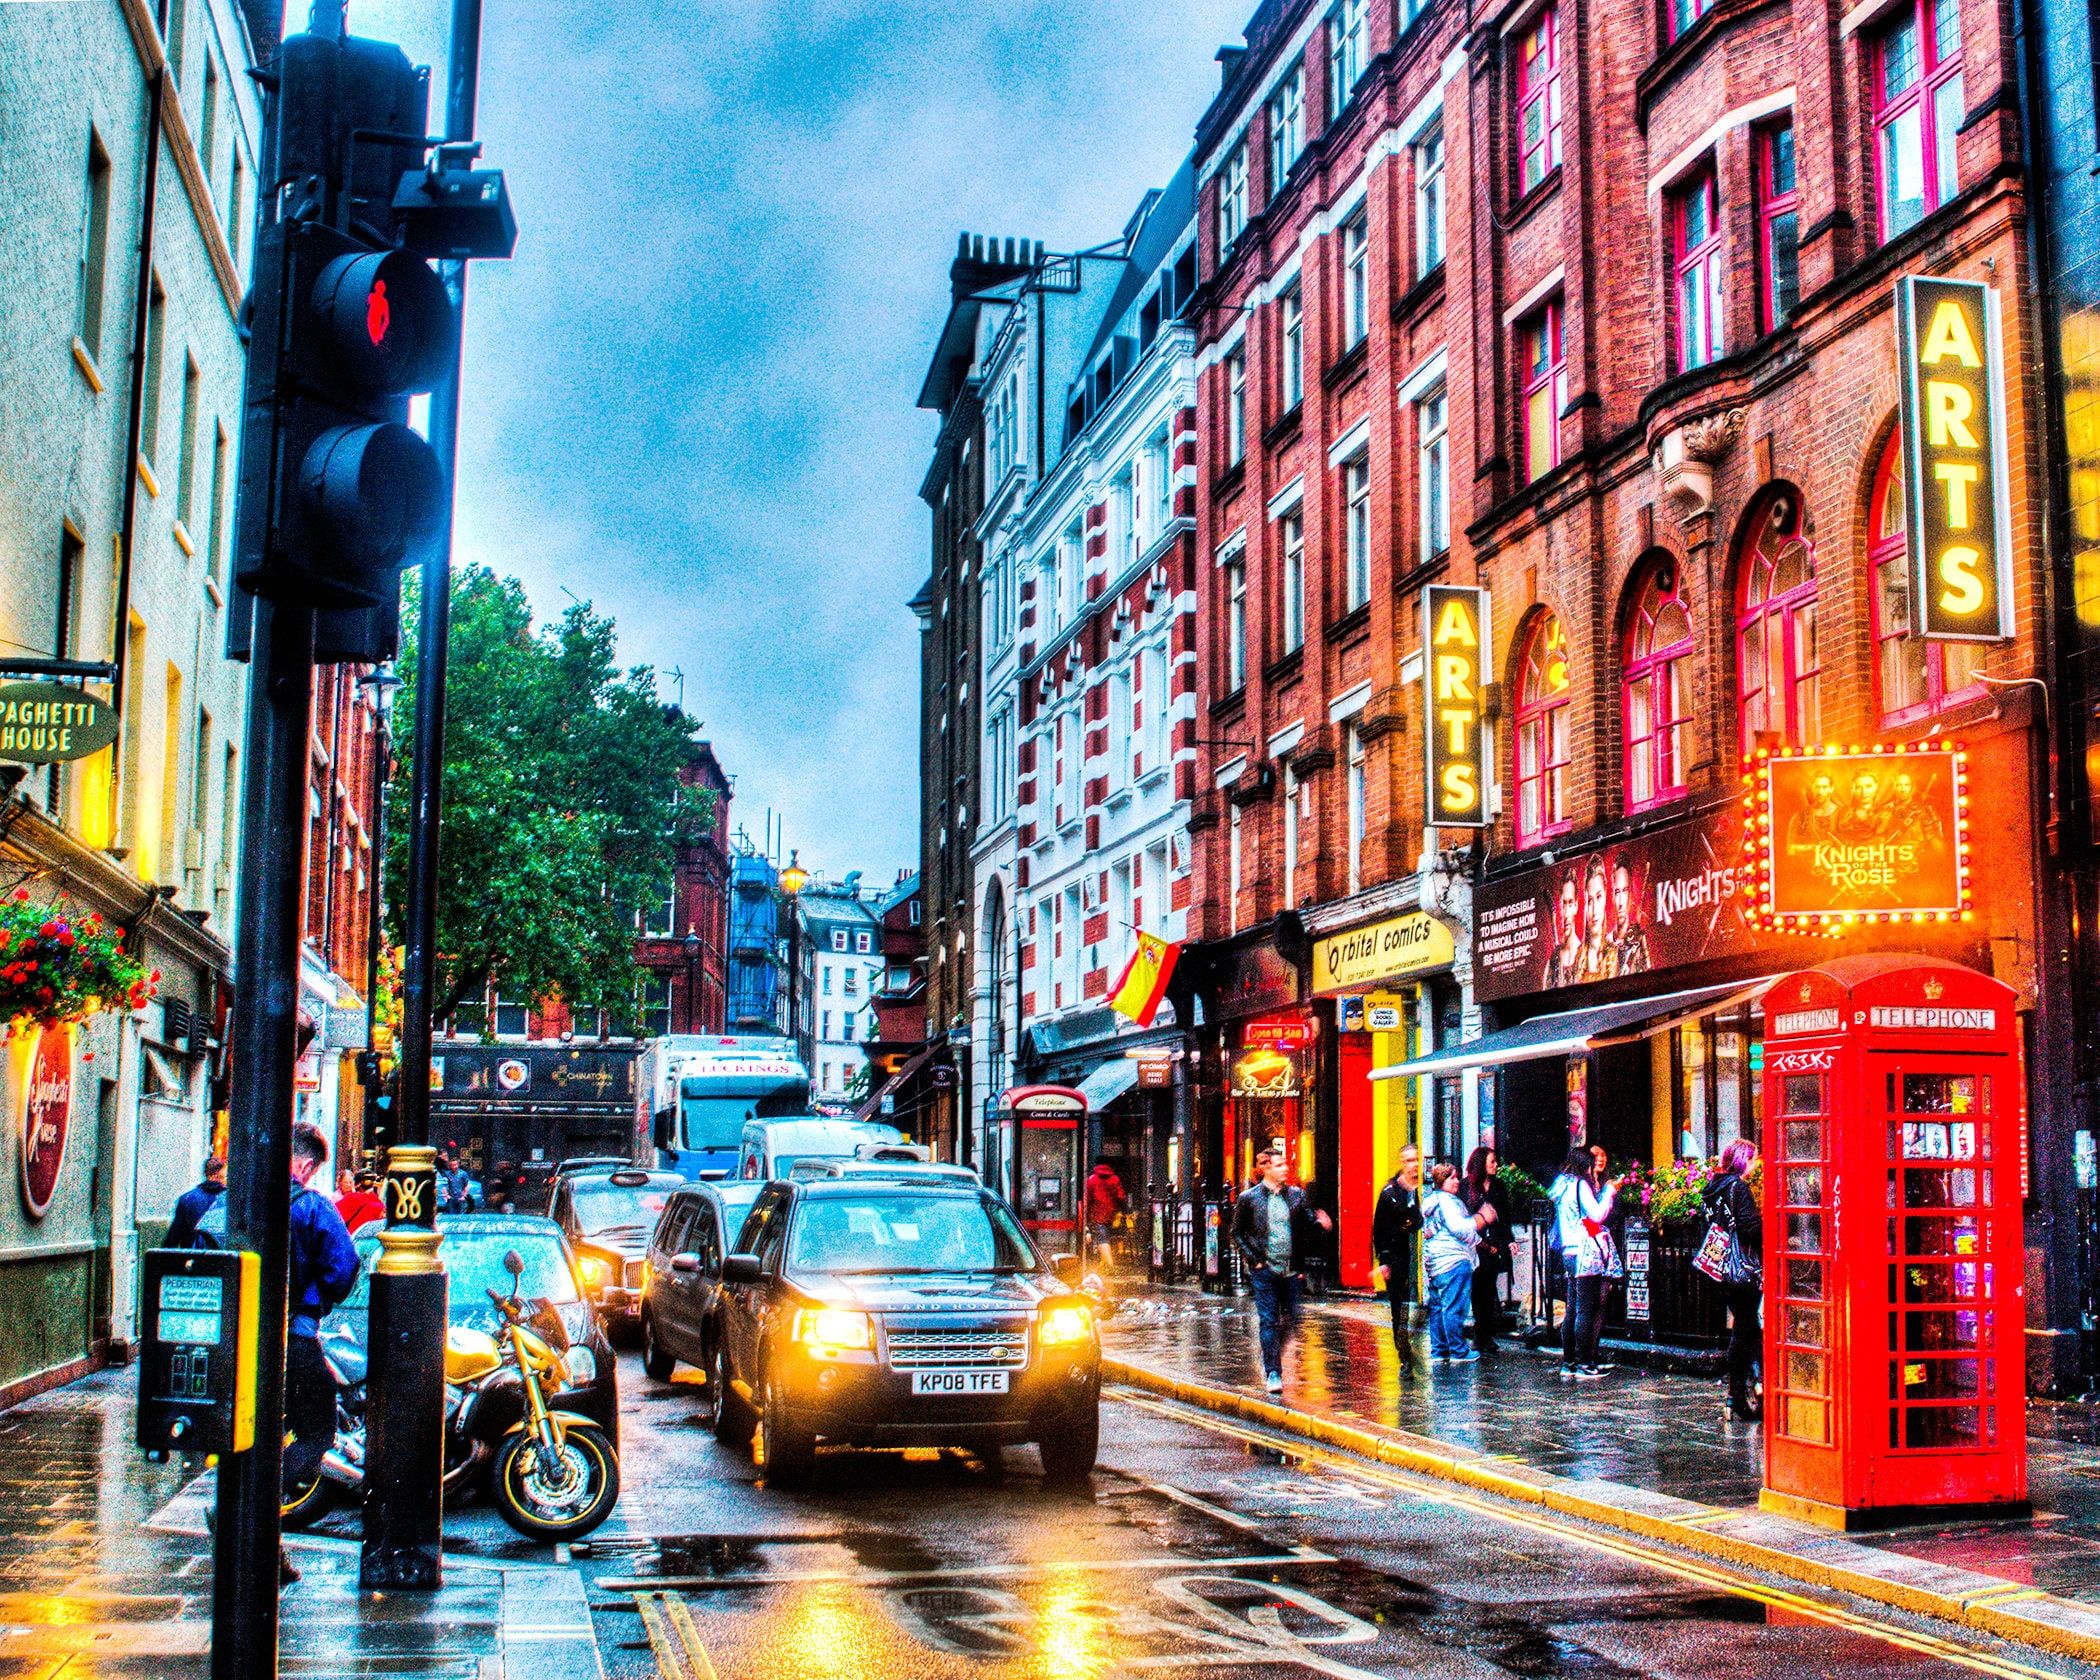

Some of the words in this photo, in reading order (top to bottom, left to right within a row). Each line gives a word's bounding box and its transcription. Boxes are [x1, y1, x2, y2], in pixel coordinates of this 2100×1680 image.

[1920, 302, 1984, 615] ARTS
[0, 702, 96, 726] PAGHETTI
[1433, 601, 1477, 811] ARTS
[1, 727, 72, 752] HOUSE
[1814, 844, 1914, 869] KNIGHTS
[1852, 861, 1865, 869] OF
[1870, 860, 1889, 868] THE
[1831, 863, 1897, 889] ROSE
[1656, 862, 1736, 925] KNIGHTS
[1495, 897, 1536, 921] IMPOSSIBLE
[1384, 918, 1432, 951] comics
[1490, 918, 1518, 936] IMAGINE
[1518, 912, 1537, 928] HOW
[1484, 934, 1513, 951] MUSICAL
[1514, 927, 1539, 944] COULD
[1483, 954, 1494, 967] BE
[1494, 949, 1513, 963] MORE
[1777, 1009, 1838, 1032] TELEPHONE
[1875, 1008, 1992, 1029] TELEPHONE
[166, 1279, 221, 1288] PEDESTRIANS
[887, 1302, 942, 1310] LAND
[953, 1302, 1018, 1310] ROVER
[920, 1374, 964, 1390] KP08
[970, 1374, 1001, 1390] TFE
